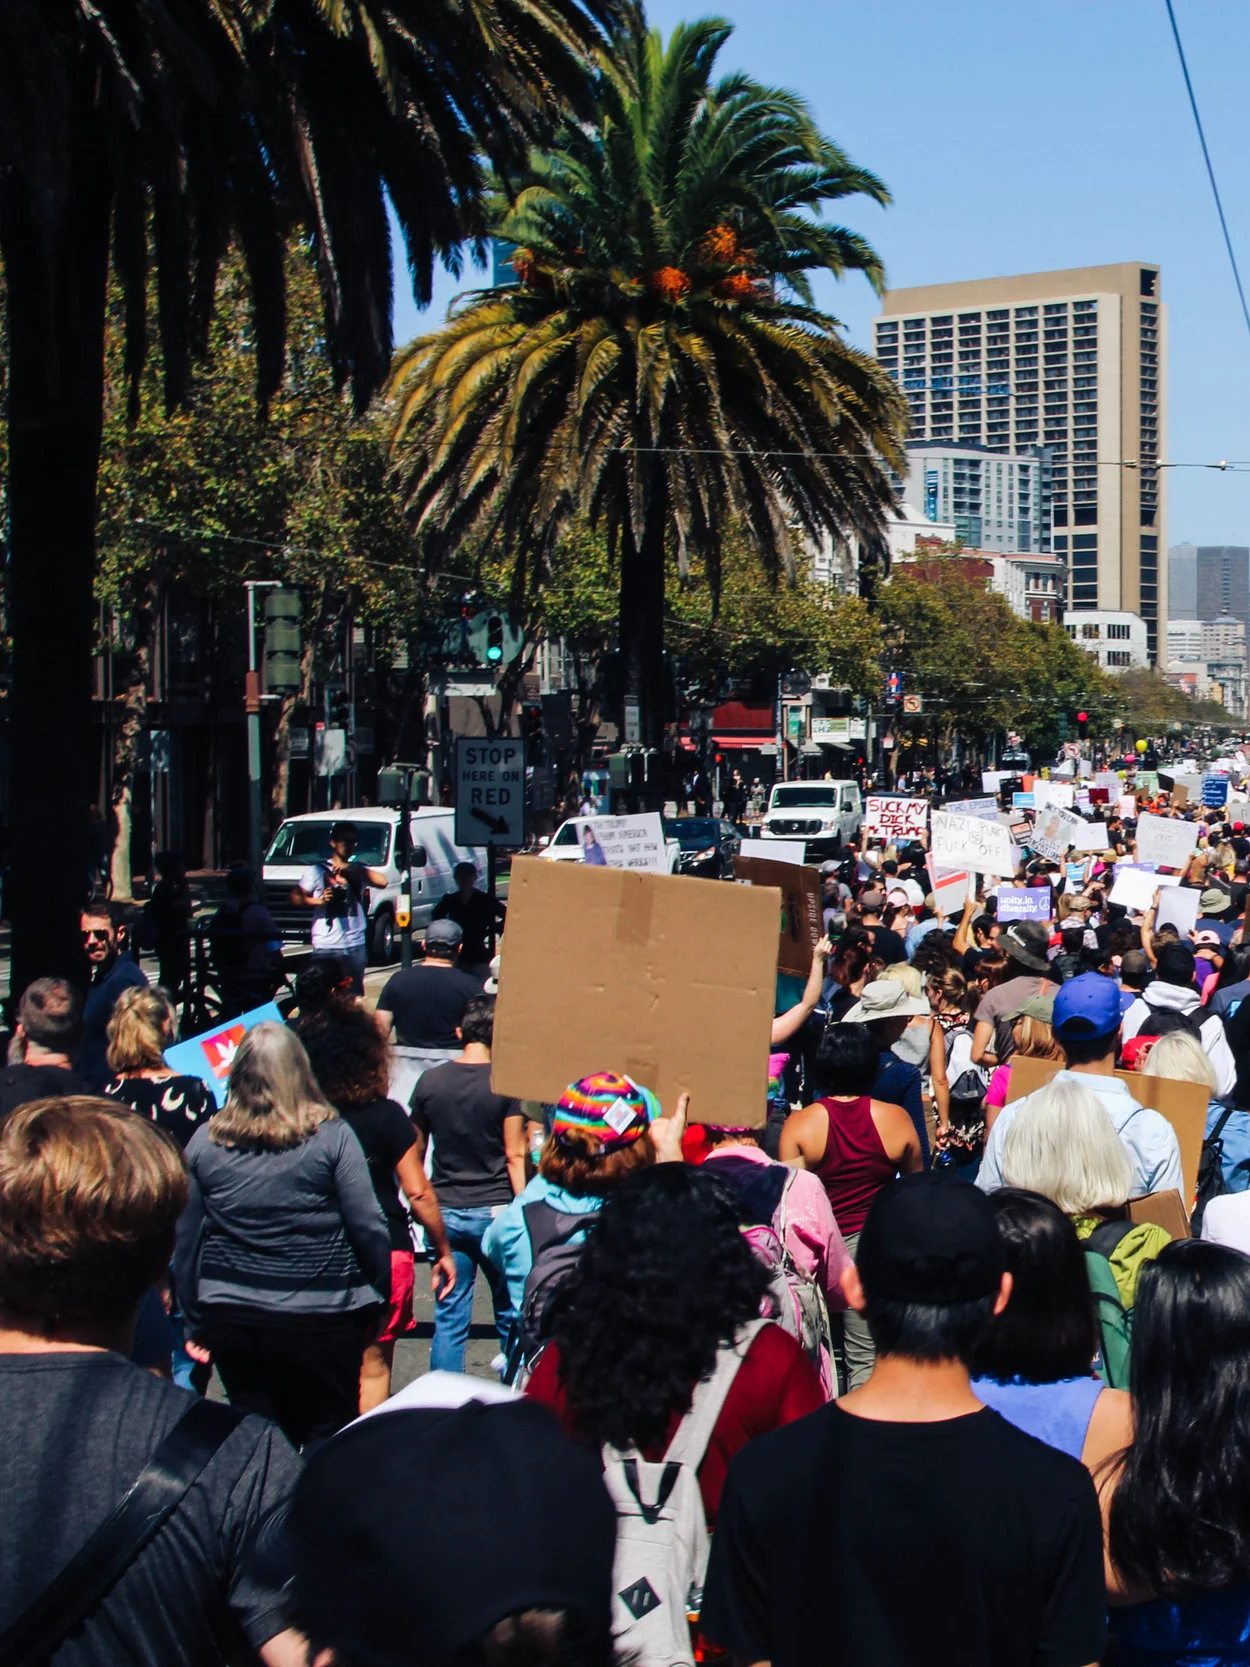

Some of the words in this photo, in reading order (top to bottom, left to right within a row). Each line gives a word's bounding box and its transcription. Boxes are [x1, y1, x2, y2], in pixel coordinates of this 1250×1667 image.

[466, 748, 516, 765] STOP
[462, 770, 495, 781] HERE
[502, 770, 519, 781] ON
[471, 787, 511, 805] RED
[868, 799, 904, 813] SUCK
[906, 802, 927, 815] MY
[880, 814, 914, 825] DICK
[936, 816, 971, 831] NAZI
[880, 825, 923, 836] TRUMP
[937, 836, 968, 852] FUCK
[807, 892, 817, 922] UPSIDE
